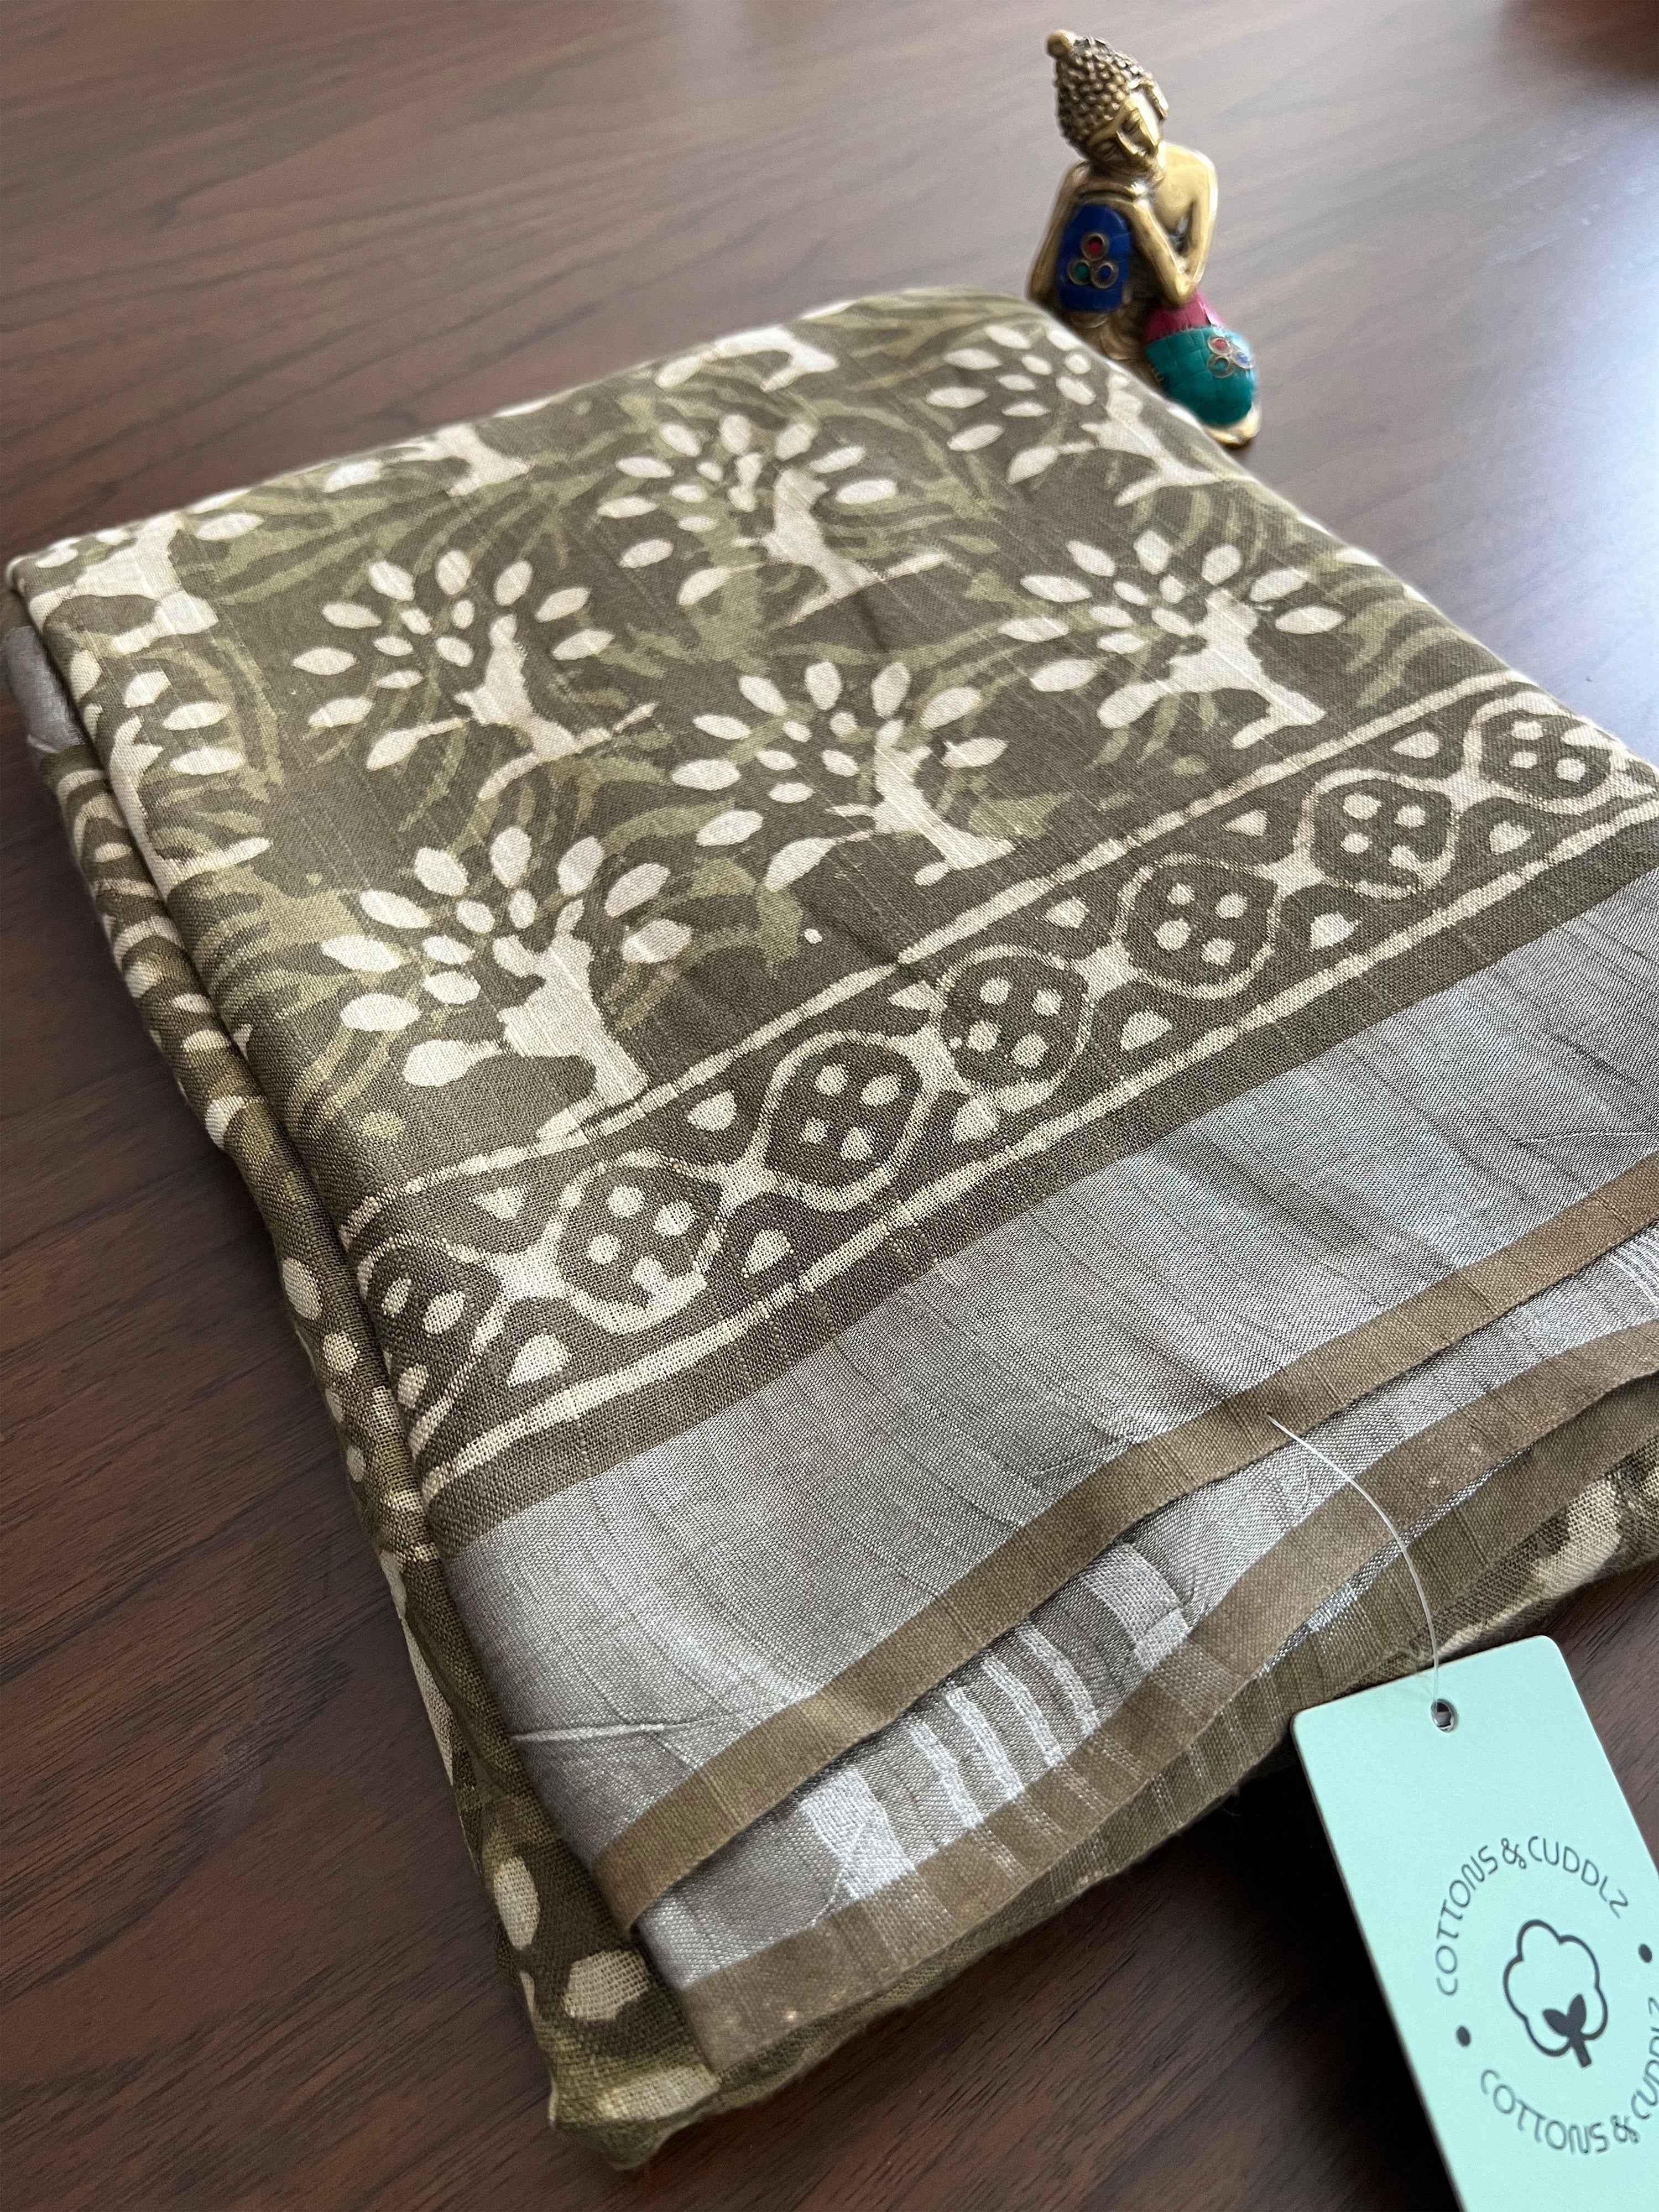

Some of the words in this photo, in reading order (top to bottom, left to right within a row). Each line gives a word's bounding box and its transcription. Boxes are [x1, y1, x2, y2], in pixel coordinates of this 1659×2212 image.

[1435, 1844, 1499, 1996] COTTONS
[1527, 1835, 1629, 1919] CUDDLZ
[1480, 2068, 1610, 2155] COTTONS
